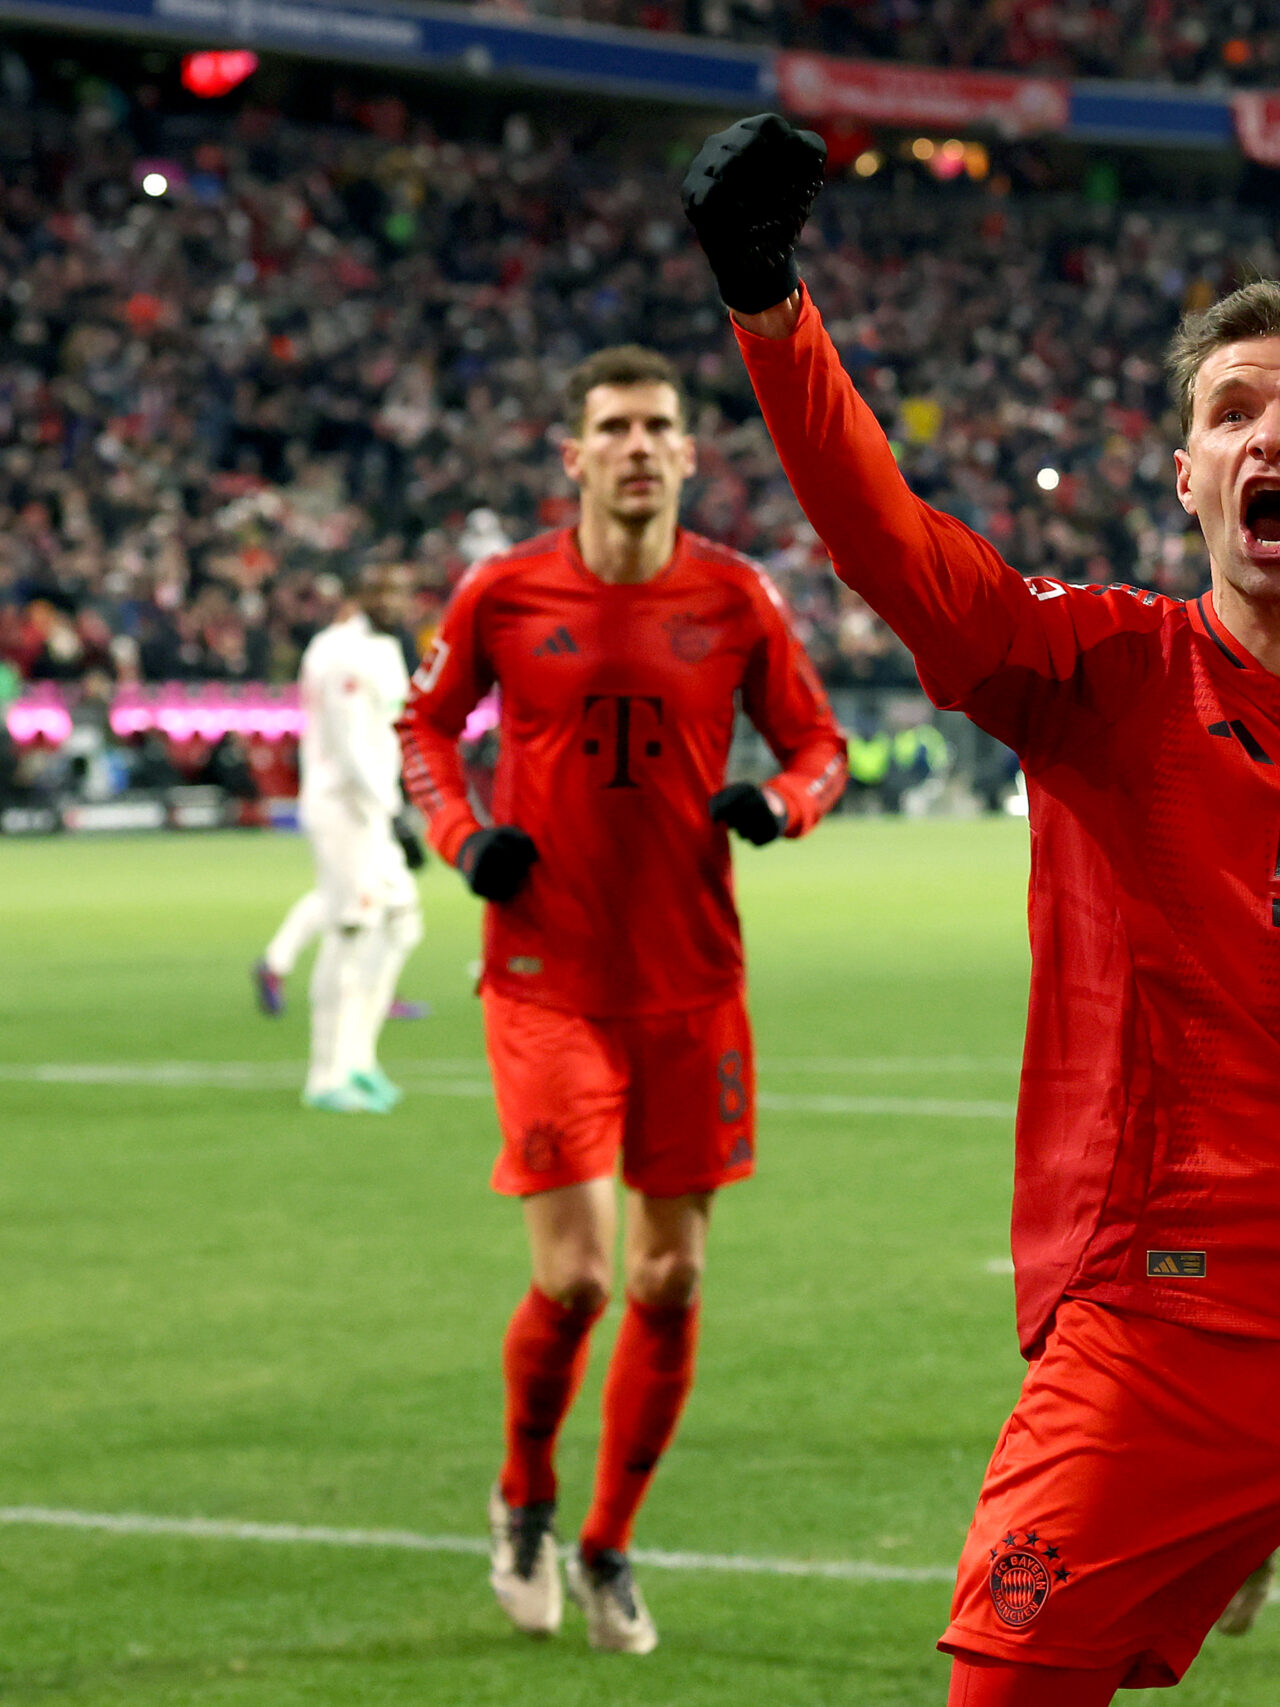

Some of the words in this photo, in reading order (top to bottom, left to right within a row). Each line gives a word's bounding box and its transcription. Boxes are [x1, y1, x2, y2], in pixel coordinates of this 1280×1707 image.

[716, 1049, 748, 1124] 8
[994, 1561, 1009, 1578] FC
[1010, 1555, 1046, 1591] BAYERN
